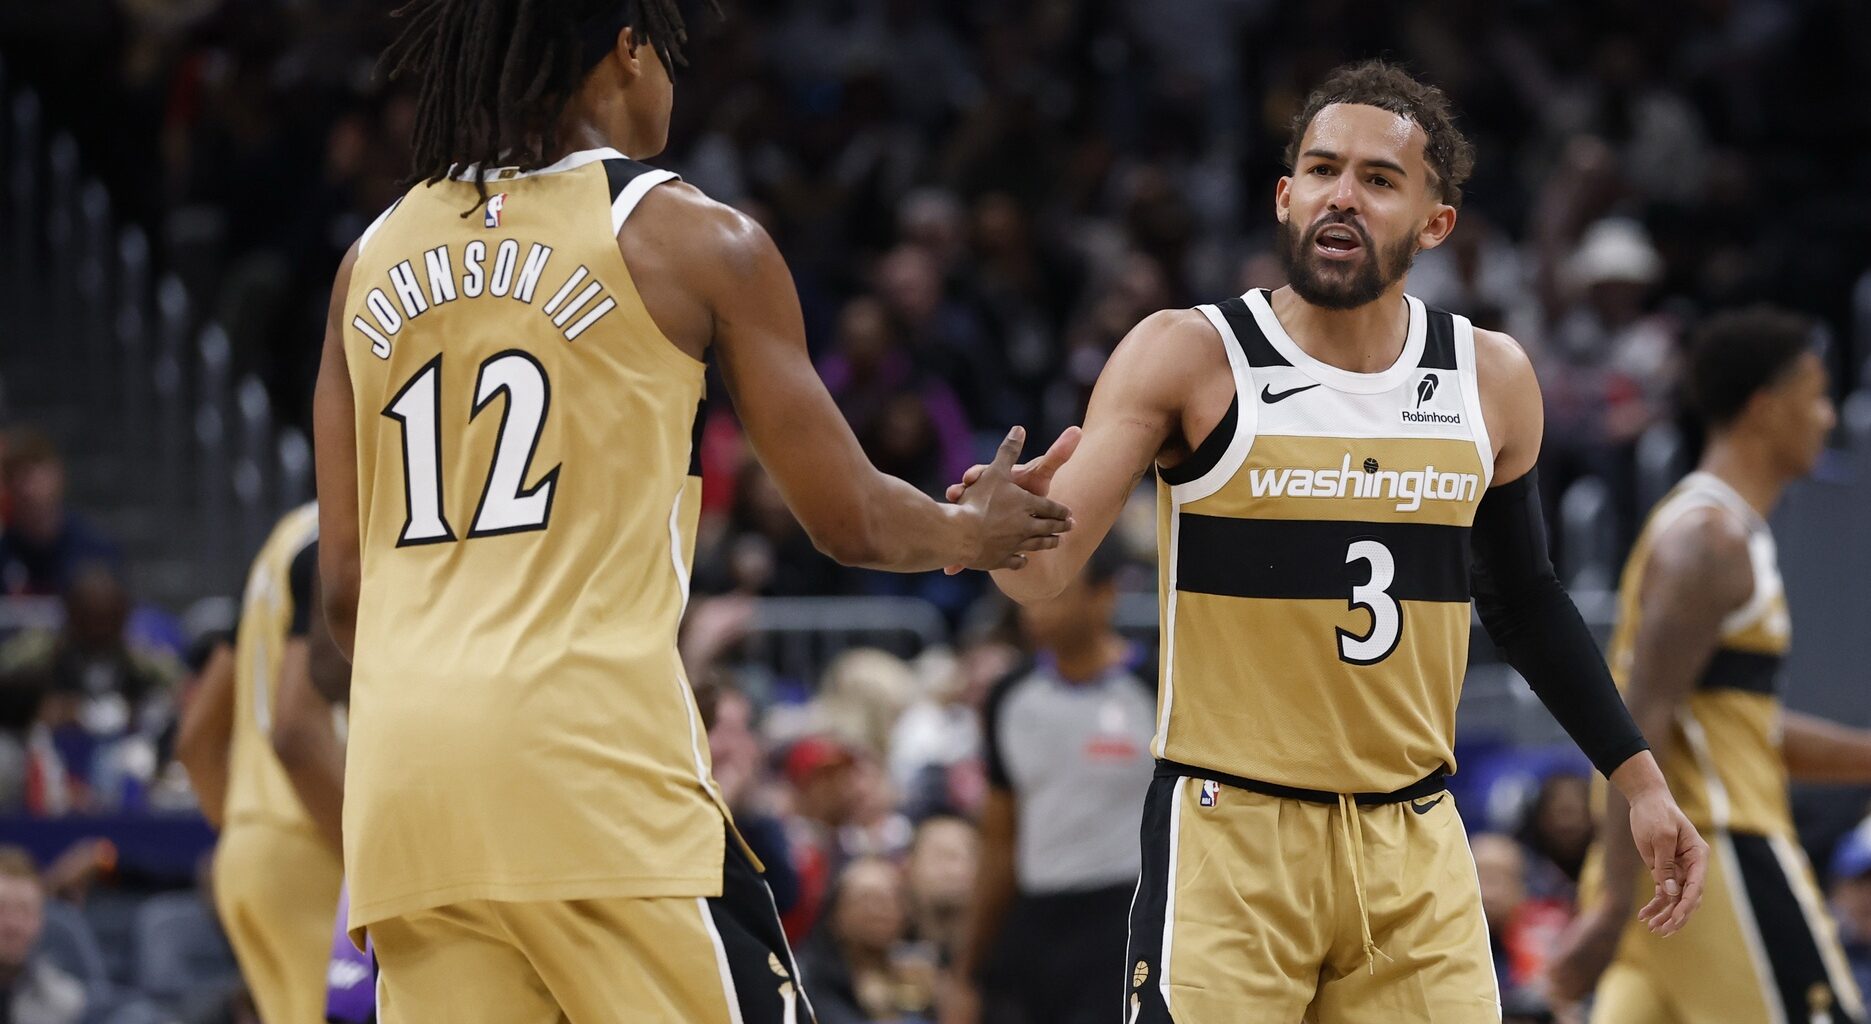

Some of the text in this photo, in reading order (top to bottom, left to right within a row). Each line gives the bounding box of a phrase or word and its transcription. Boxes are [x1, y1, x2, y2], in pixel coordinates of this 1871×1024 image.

[352, 238, 617, 360] JOHNSON III
[380, 348, 563, 548] 12
[1402, 411, 1461, 424] Robinhood
[1249, 452, 1479, 512] washington
[1335, 538, 1404, 666] 3
